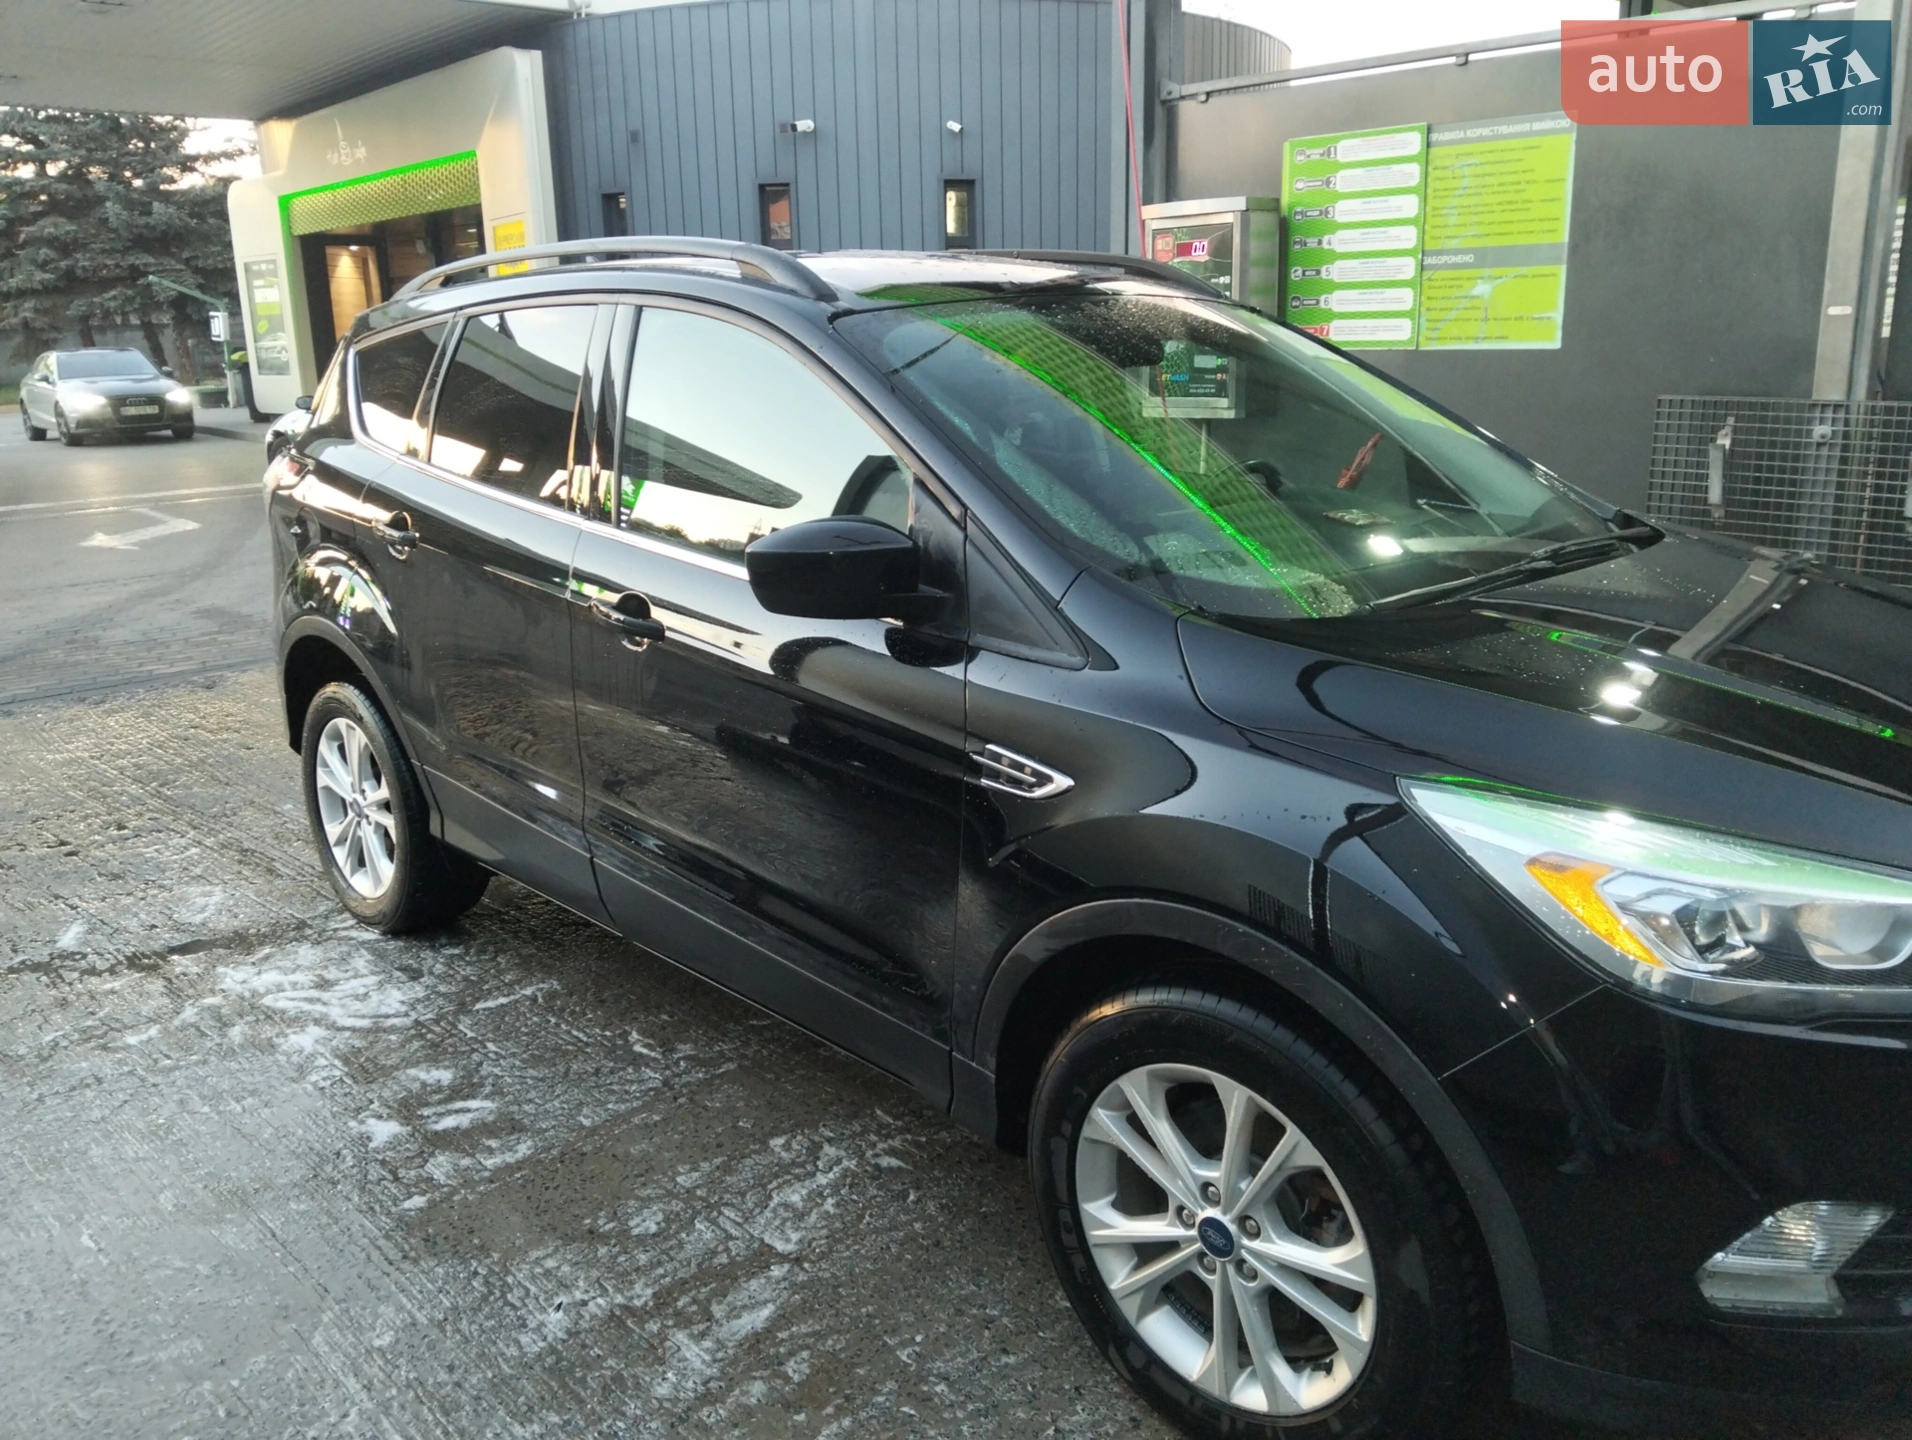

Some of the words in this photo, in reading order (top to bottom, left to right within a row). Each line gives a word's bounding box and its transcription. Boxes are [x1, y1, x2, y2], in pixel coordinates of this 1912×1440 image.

[1429, 128, 1465, 142] ПРАВИЛА
[1465, 122, 1531, 138] КОРИСТУВАННЯ
[1532, 118, 1571, 131] МИЙКОЮ
[1329, 146, 1336, 158] 1
[1329, 177, 1336, 188] 2
[1327, 207, 1335, 218] 3
[1325, 236, 1332, 248] 4
[1422, 254, 1475, 265] ЗАБОРОНЕНО
[1325, 267, 1332, 277] 5
[1323, 297, 1330, 307] 6
[1322, 325, 1329, 336] 7
